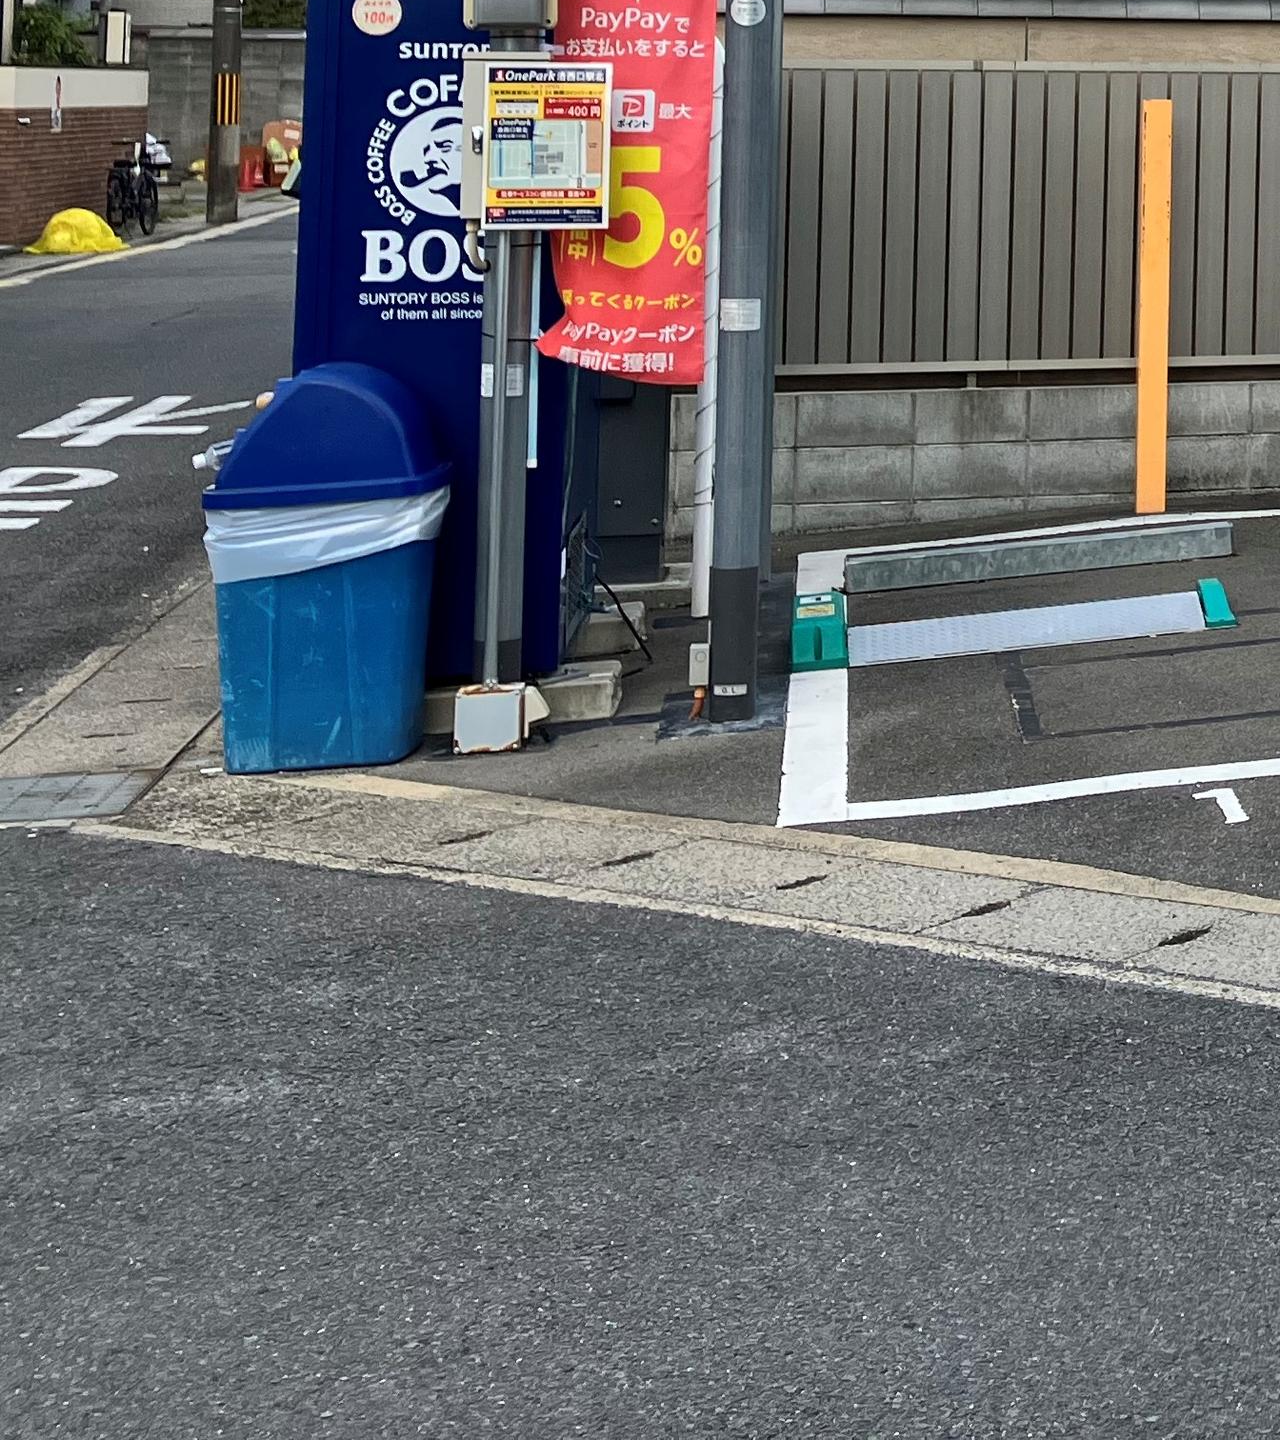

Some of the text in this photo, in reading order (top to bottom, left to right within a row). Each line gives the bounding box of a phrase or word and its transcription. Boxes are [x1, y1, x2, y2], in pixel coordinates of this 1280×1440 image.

[581, 7, 690, 33] PayPayで
[399, 42, 490, 59] SUNTO
[566, 38, 705, 57] お支払いをすると
[506, 70, 556, 81] OnePark
[387, 74, 464, 117] COF
[658, 103, 692, 119] 最大
[617, 119, 649, 128] ポイント
[366, 118, 416, 226] BOSS COFFEE
[359, 292, 483, 305] SUNTORY BOSS is
[381, 308, 482, 320] of them all since
[1192, 787, 1250, 825] 1
